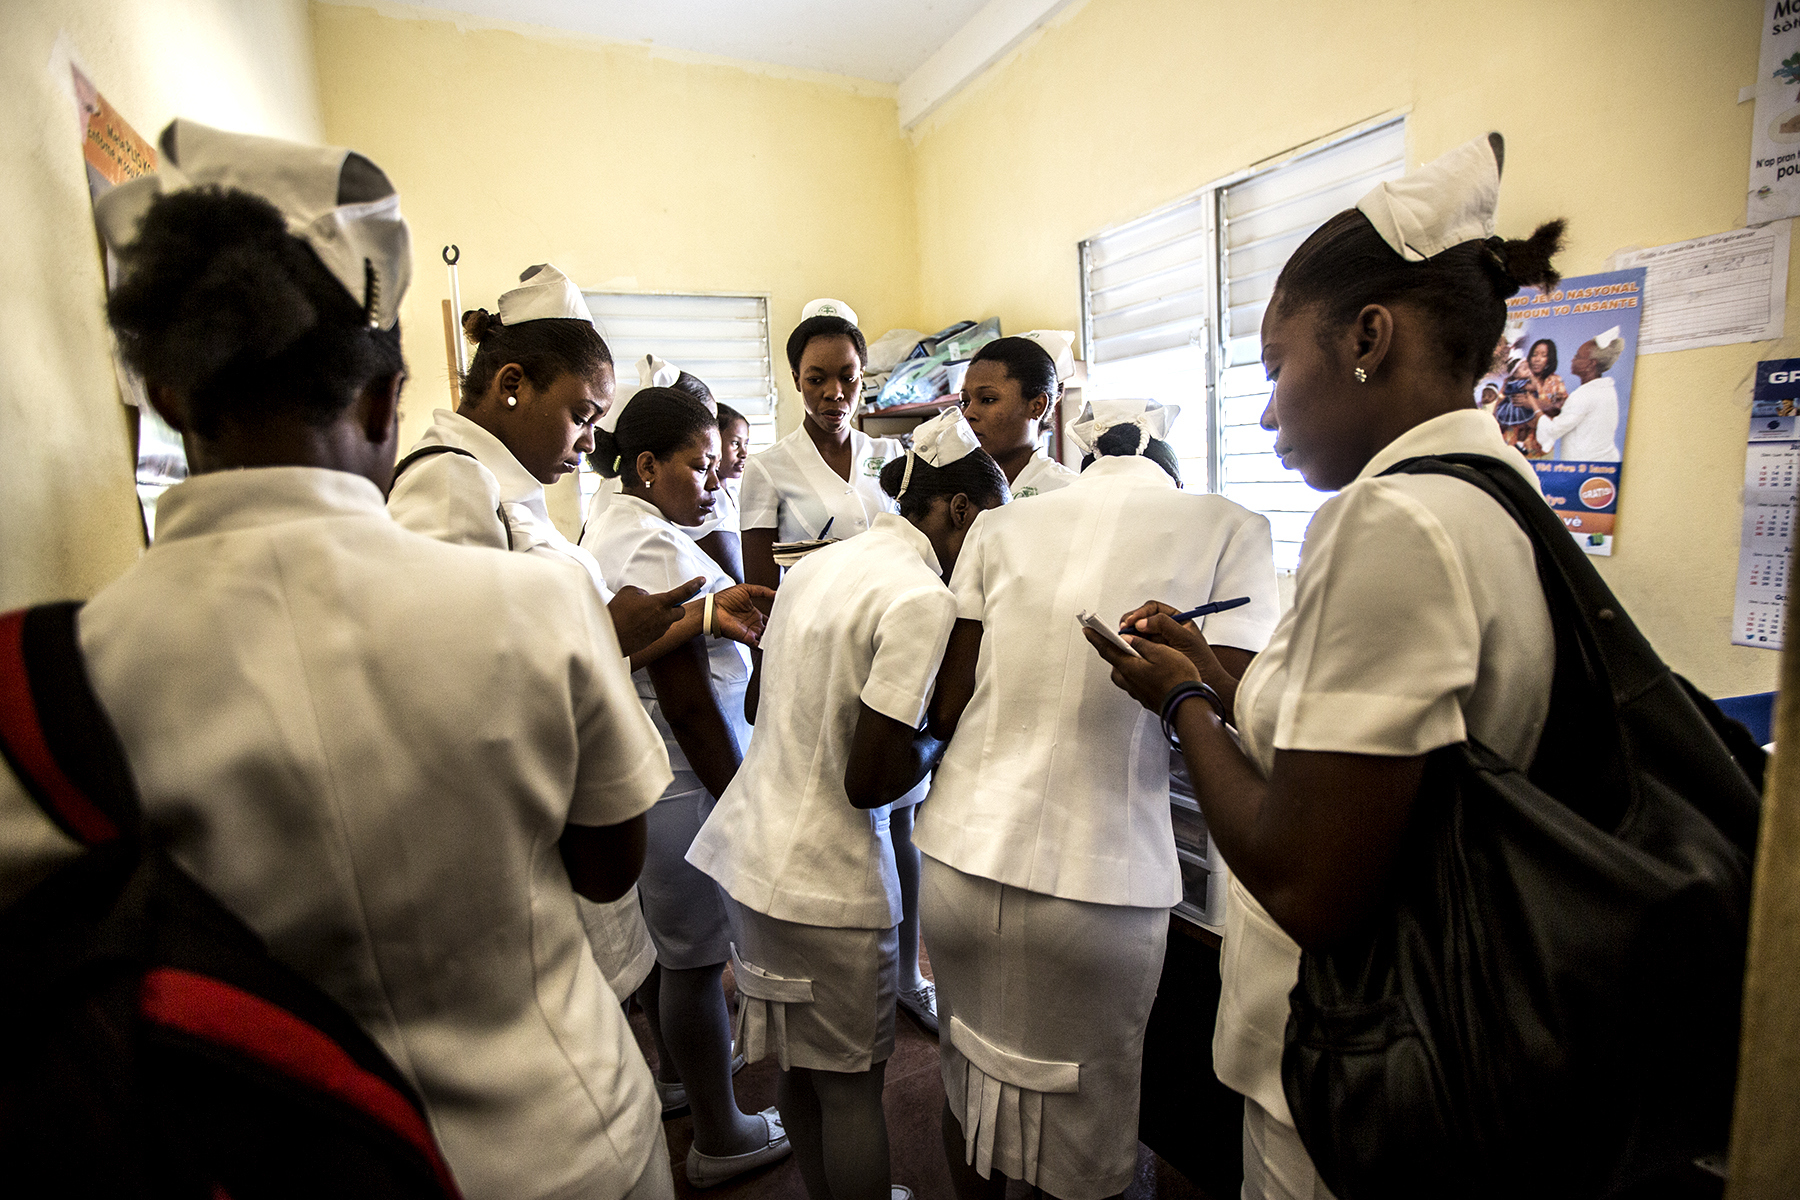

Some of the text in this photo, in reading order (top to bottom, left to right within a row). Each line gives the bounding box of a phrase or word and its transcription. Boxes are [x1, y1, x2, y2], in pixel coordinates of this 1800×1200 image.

[1566, 282, 1640, 300] NASYONAL
[1552, 305, 1571, 317] YO
[1572, 297, 1639, 315] ANSANTE
